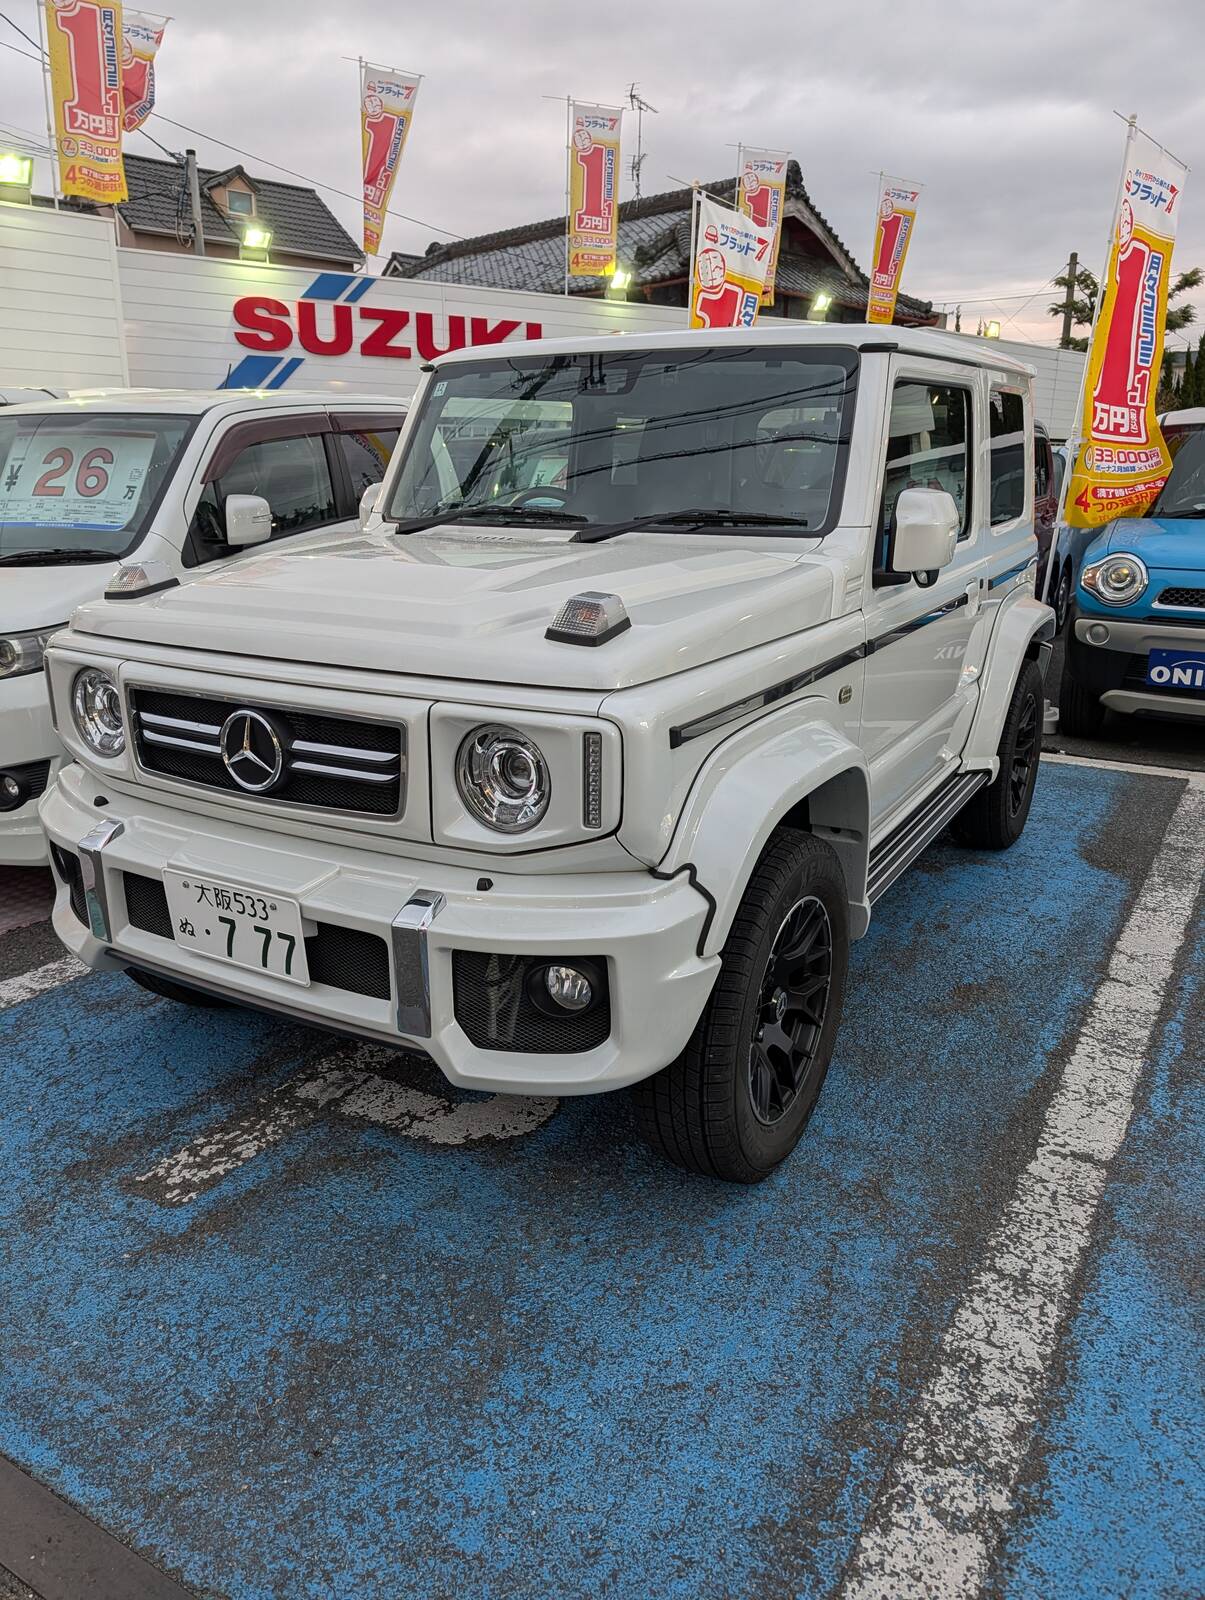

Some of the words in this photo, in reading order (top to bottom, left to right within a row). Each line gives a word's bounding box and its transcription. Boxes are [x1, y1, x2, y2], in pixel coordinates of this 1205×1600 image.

[74, 108, 106, 134] 万円
[1138, 255, 1162, 366] 月々コミコミ
[1093, 402, 1130, 433] 万円
[32, 447, 114, 498] 26
[1151, 666, 1205, 686] ONI
[179, 918, 196, 938] ぬ
